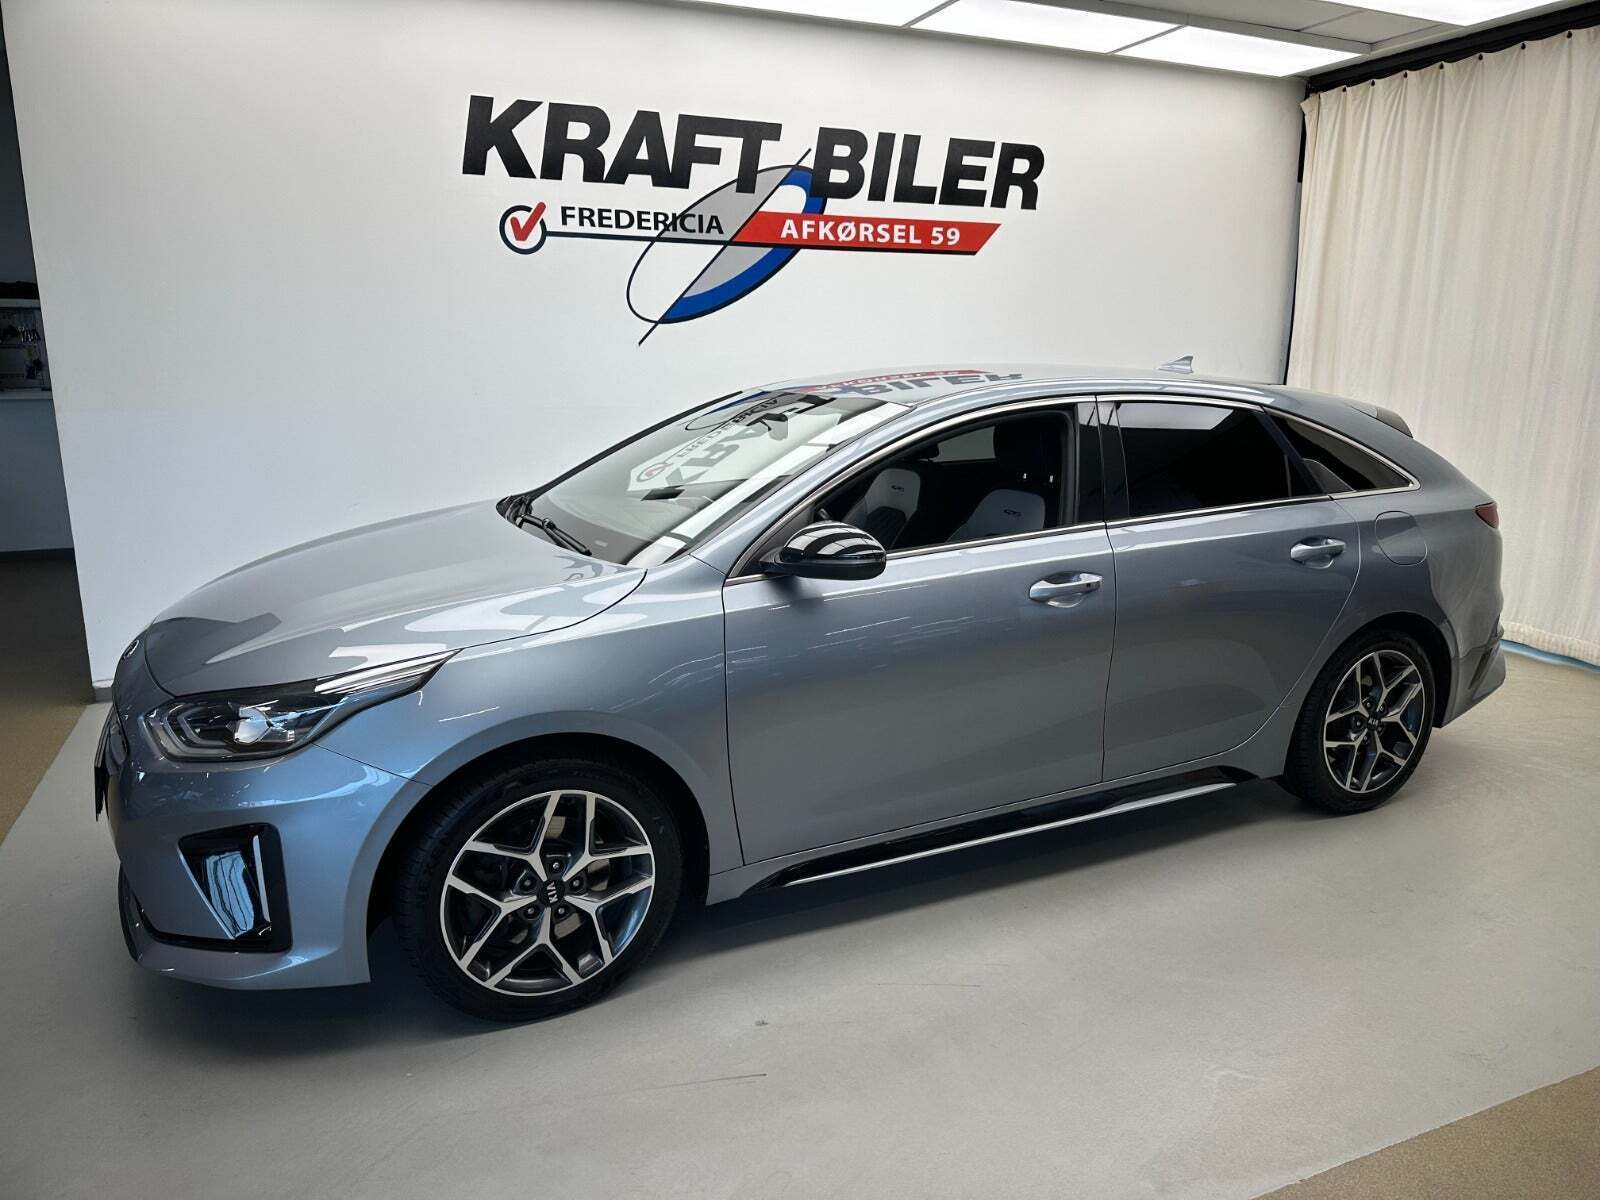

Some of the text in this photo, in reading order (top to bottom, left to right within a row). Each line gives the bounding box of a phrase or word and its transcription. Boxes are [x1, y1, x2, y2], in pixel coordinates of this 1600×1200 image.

[462, 95, 1045, 210] KRAFT BILER
[560, 206, 724, 235] FREDERICIA
[780, 219, 962, 246] AFKØRSEL 59
